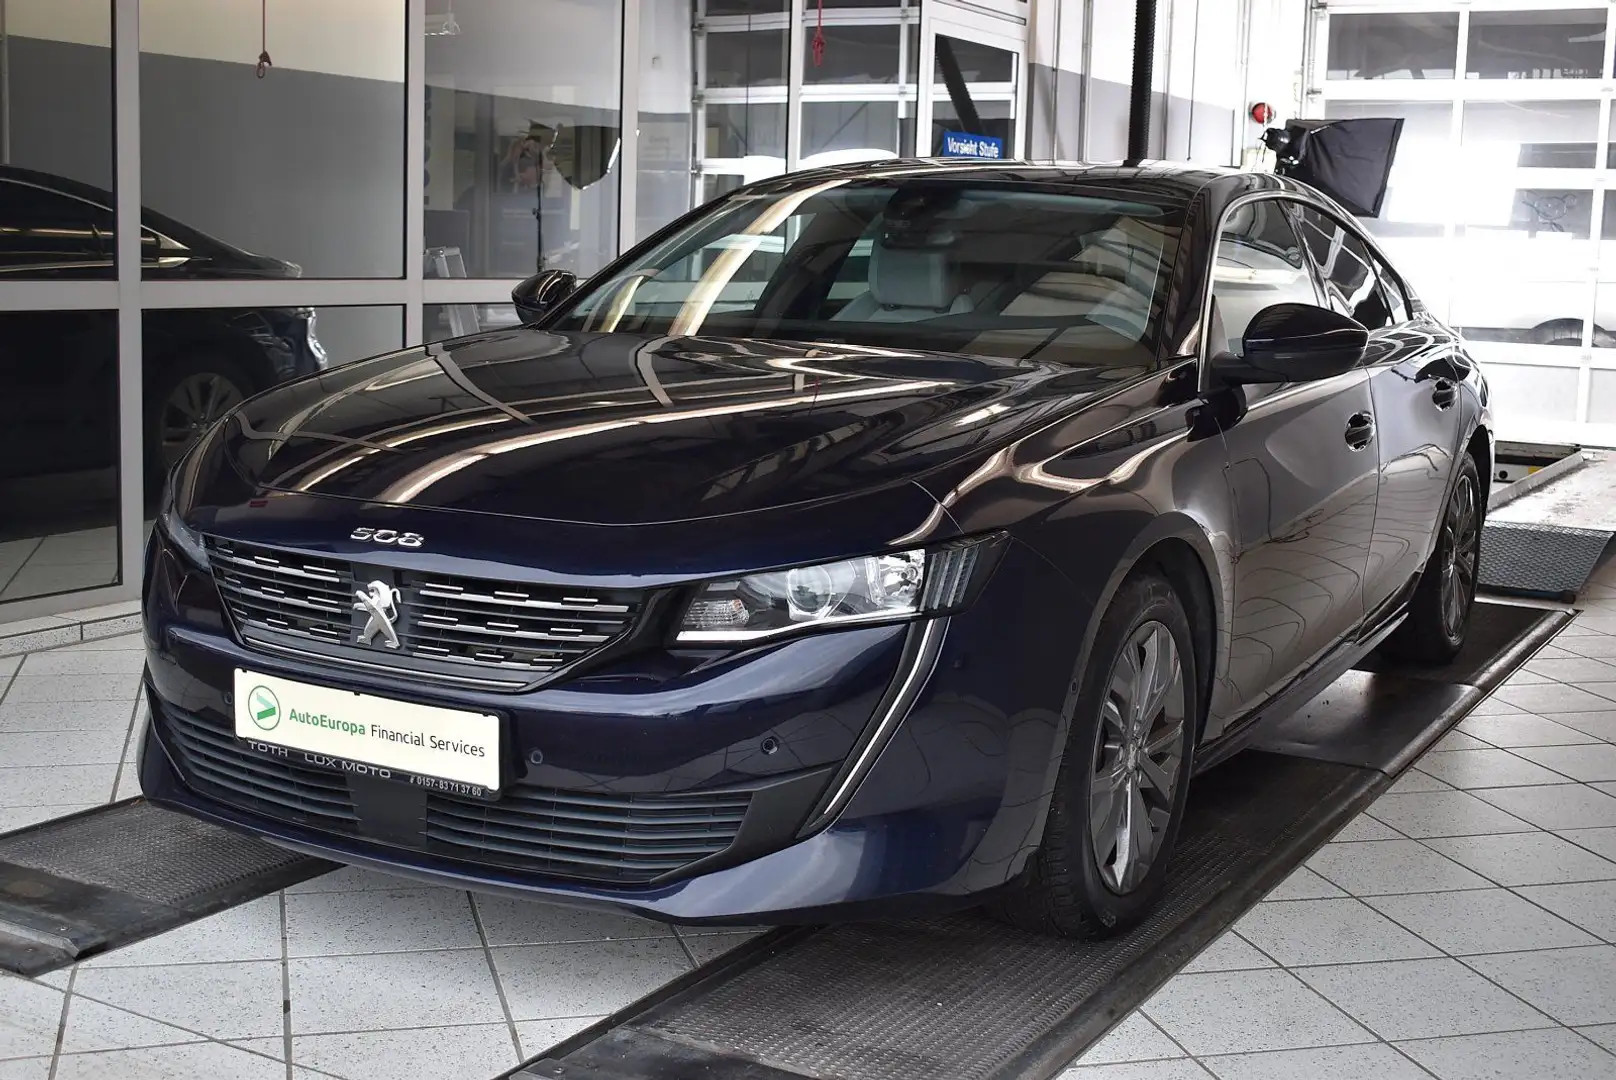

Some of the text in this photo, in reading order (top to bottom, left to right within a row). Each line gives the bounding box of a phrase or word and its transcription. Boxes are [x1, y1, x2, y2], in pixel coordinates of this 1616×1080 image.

[947, 136, 999, 158] Vorsicht Stufe
[350, 527, 425, 548] 508
[289, 708, 486, 758] AutoEuropa Financial Services
[247, 740, 391, 778] TOTH LUX MOTO
